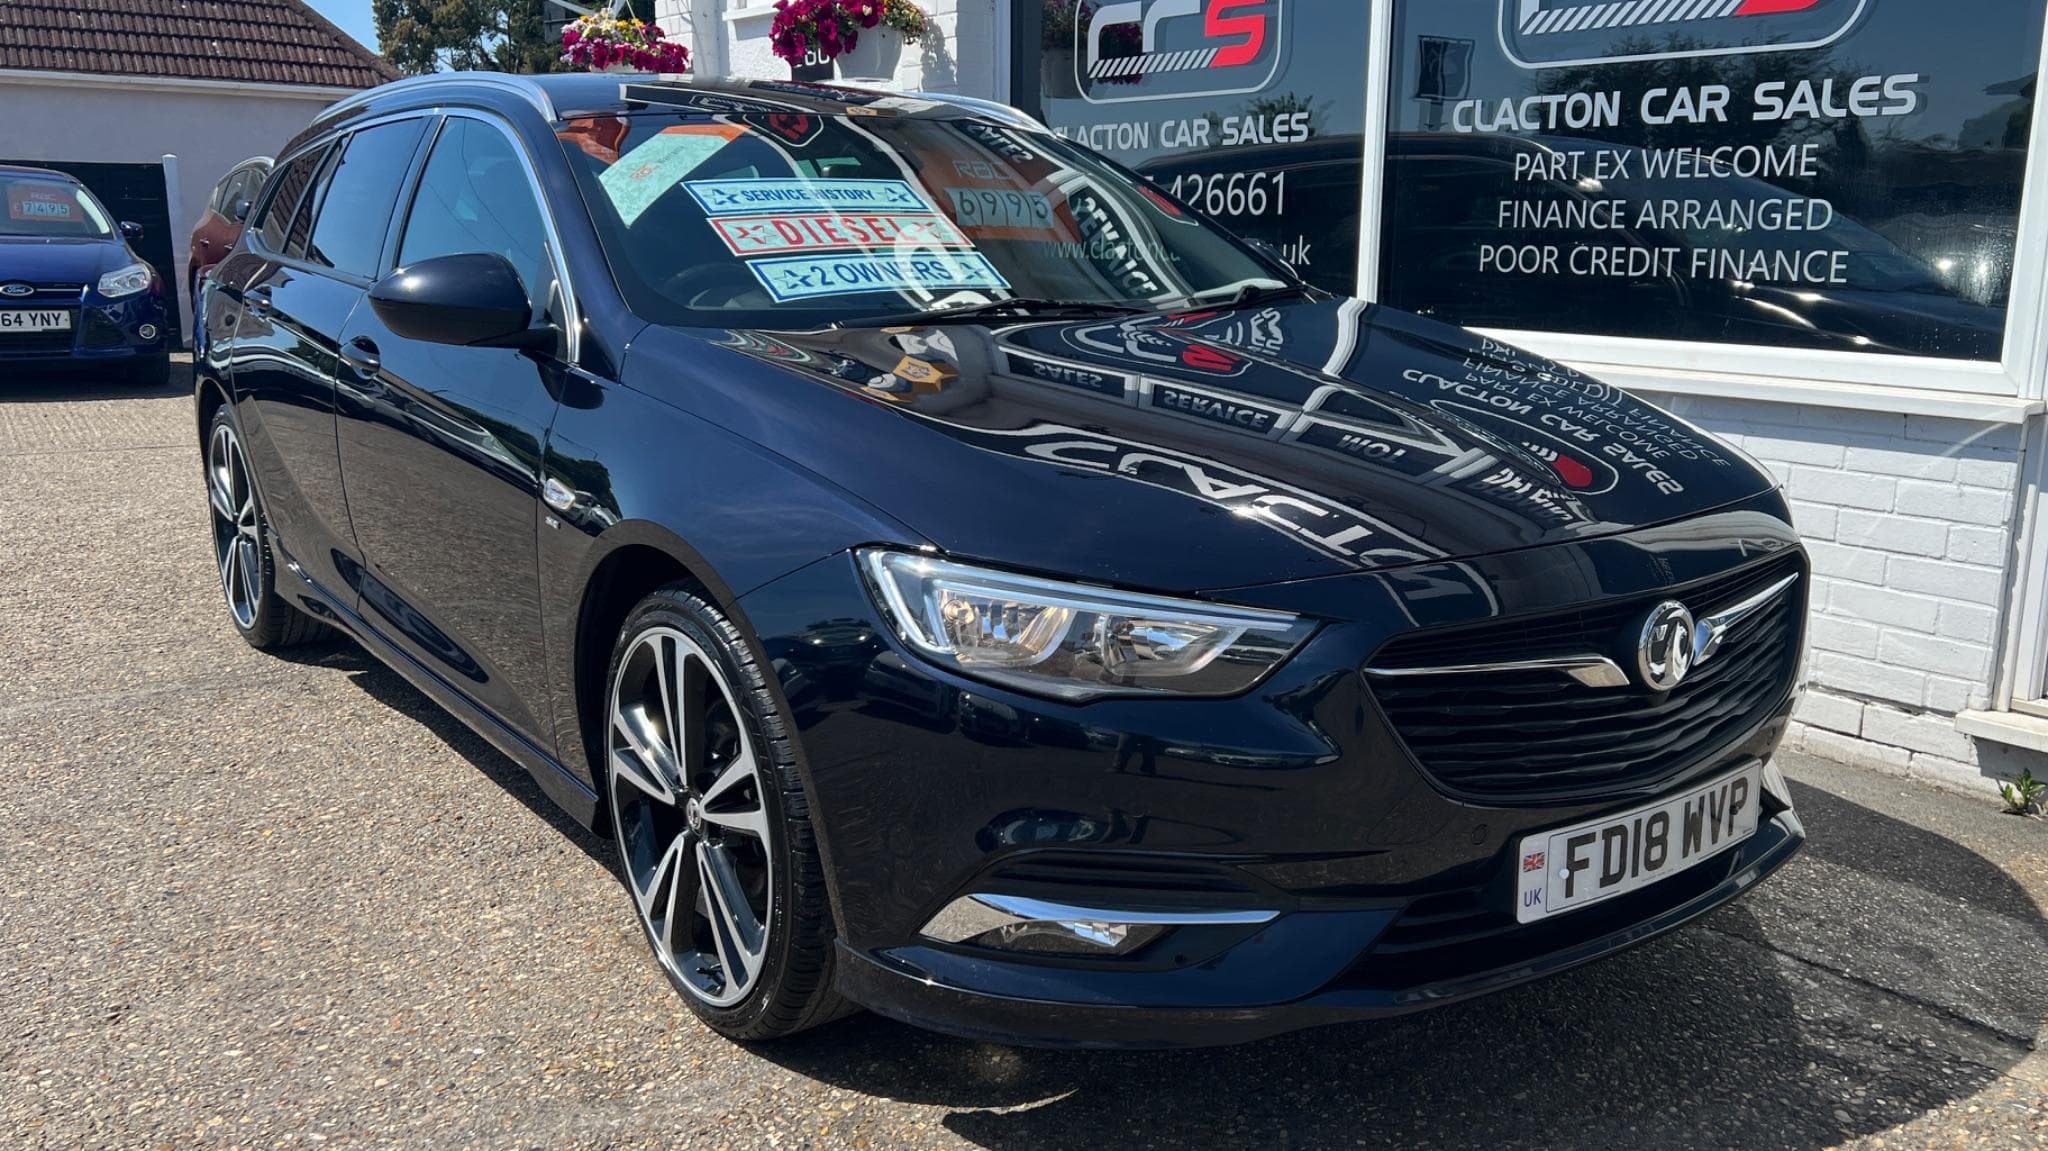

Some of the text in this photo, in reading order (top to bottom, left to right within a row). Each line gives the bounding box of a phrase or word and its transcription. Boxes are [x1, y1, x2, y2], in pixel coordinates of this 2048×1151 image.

[1453, 73, 1920, 133] CLACTON CAR SALES
[1160, 117, 1212, 148] CAR
[1222, 112, 1309, 146] SALES
[1515, 143, 1819, 181] PART EX WELCOME
[740, 188, 877, 202] SERVICE HISTORY
[959, 190, 1048, 220] 6995
[1498, 197, 1834, 231] FINANCE ARRANGED
[771, 215, 917, 246] DIESEL
[809, 261, 954, 287] 2 OWNERS
[1479, 244, 1850, 283] POOR CREDIT FINANCE
[1, 312, 62, 327] 64 YNY
[1565, 776, 1749, 898] FD18 WVP
[1523, 887, 1542, 907] UK
